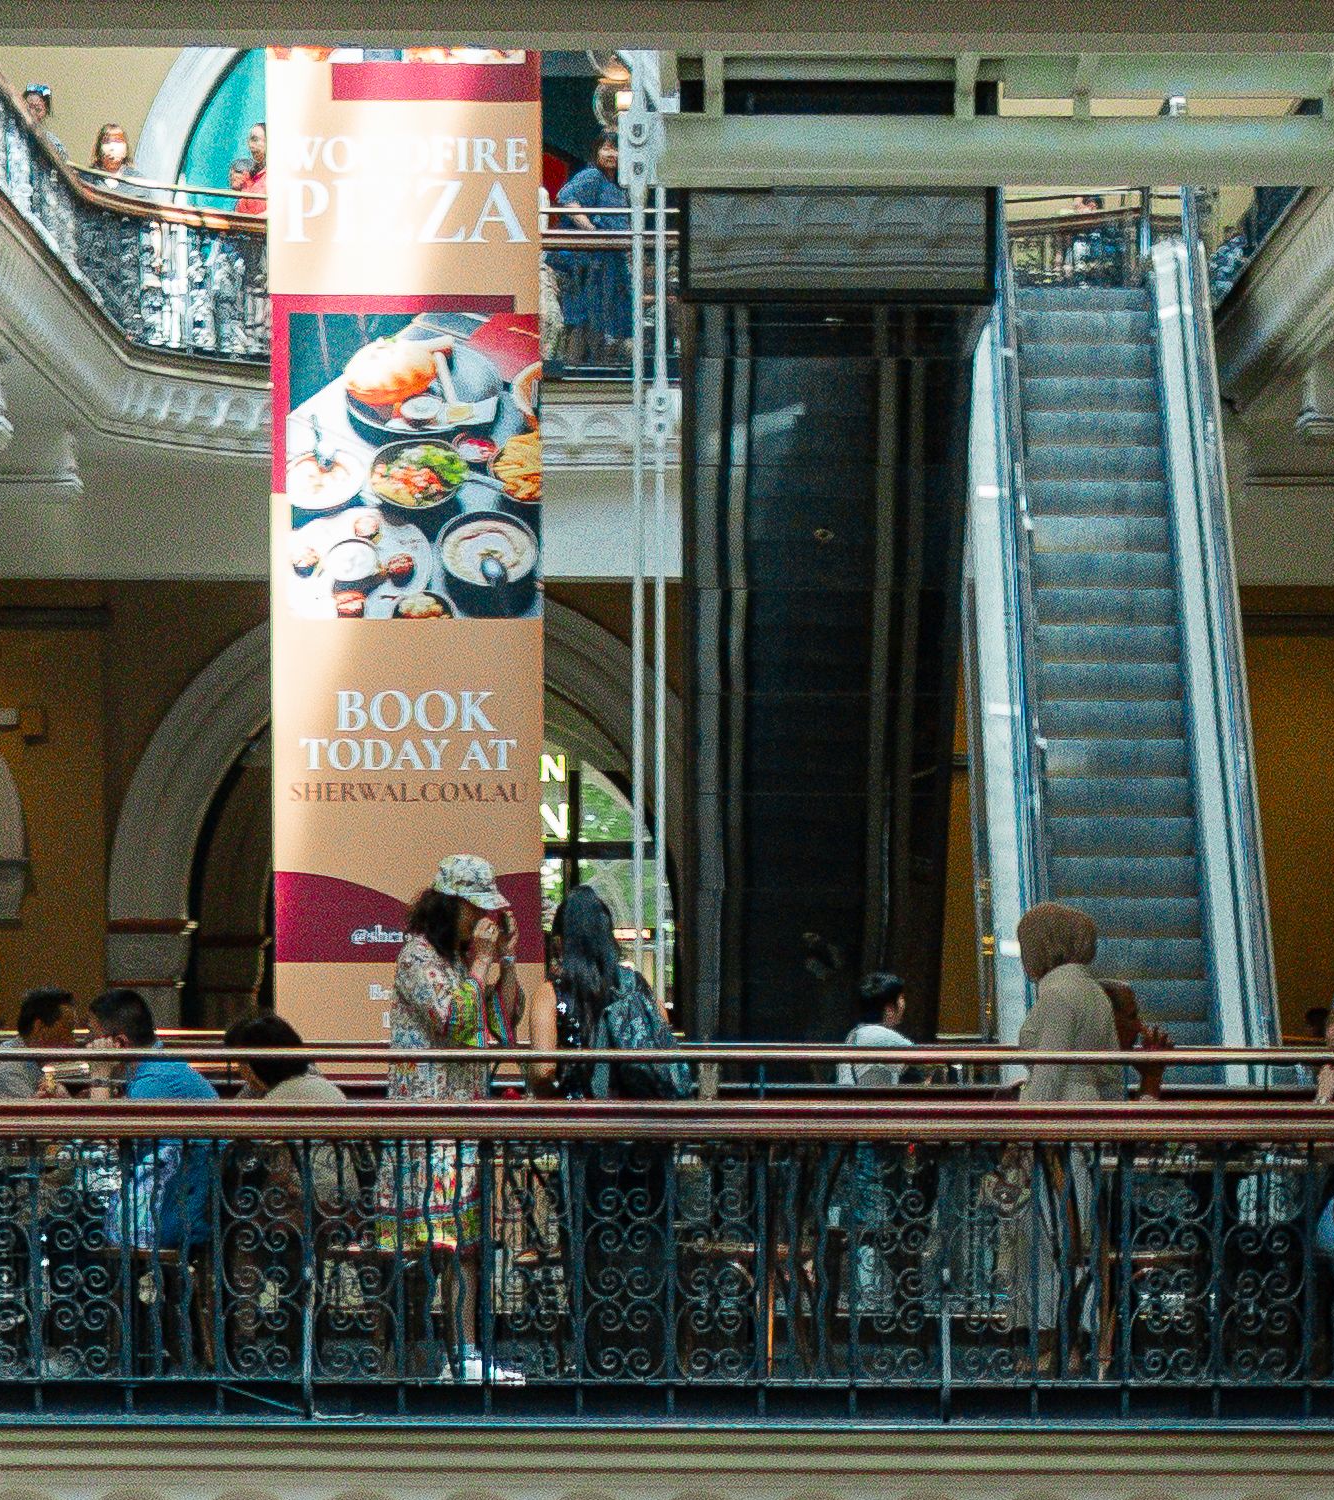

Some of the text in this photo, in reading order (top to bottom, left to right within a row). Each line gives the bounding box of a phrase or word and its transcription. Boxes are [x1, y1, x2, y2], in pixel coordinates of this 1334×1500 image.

[335, 689, 498, 733] BOOK
[298, 738, 518, 772] TODAY AT
